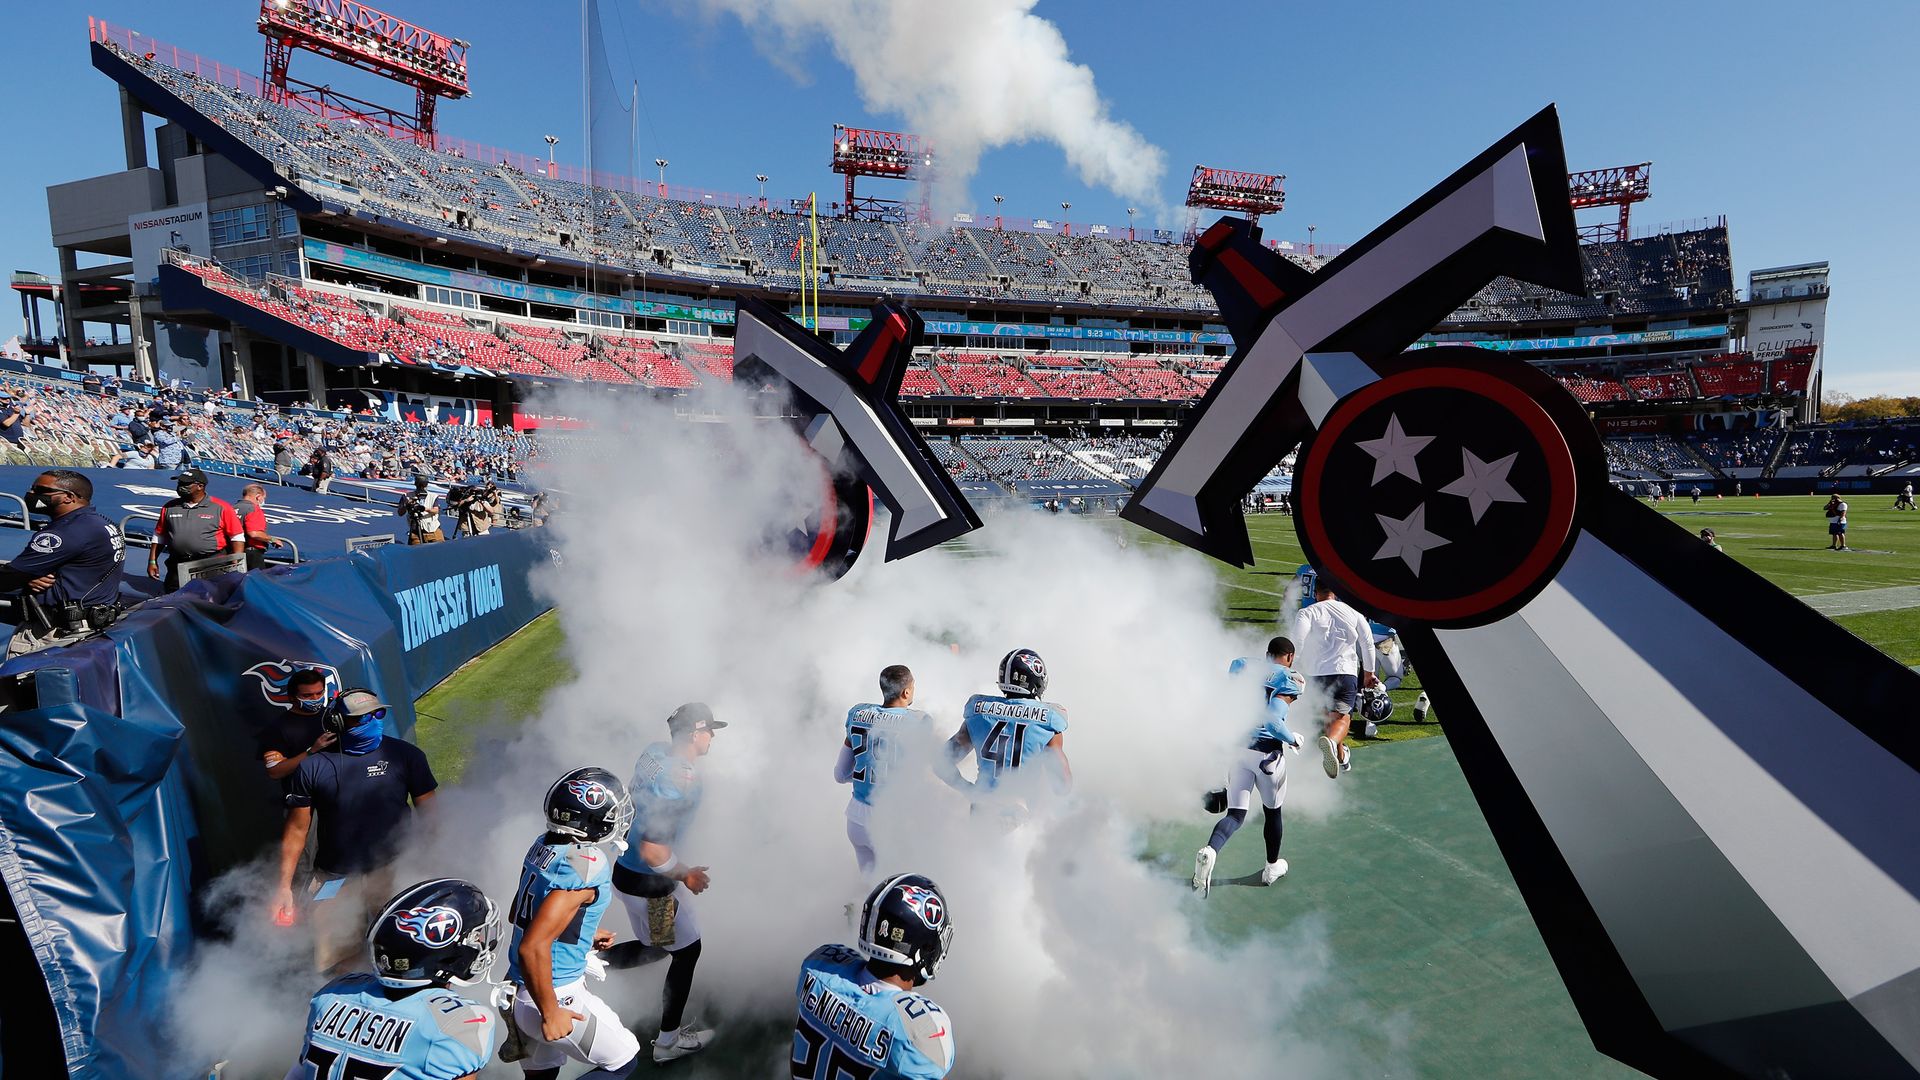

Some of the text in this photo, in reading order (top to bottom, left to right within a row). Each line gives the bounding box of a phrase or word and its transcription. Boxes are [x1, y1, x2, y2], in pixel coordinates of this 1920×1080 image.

[693, 308, 735, 322] SALUT
[1087, 329, 1103, 338] 9:23
[1607, 419, 1657, 427] NISSAN
[394, 563, 504, 652] TENNESSEE TOUGH
[974, 700, 1049, 723] BLASINGAME
[981, 719, 1029, 778] 41
[313, 1000, 414, 1055] JACKSON
